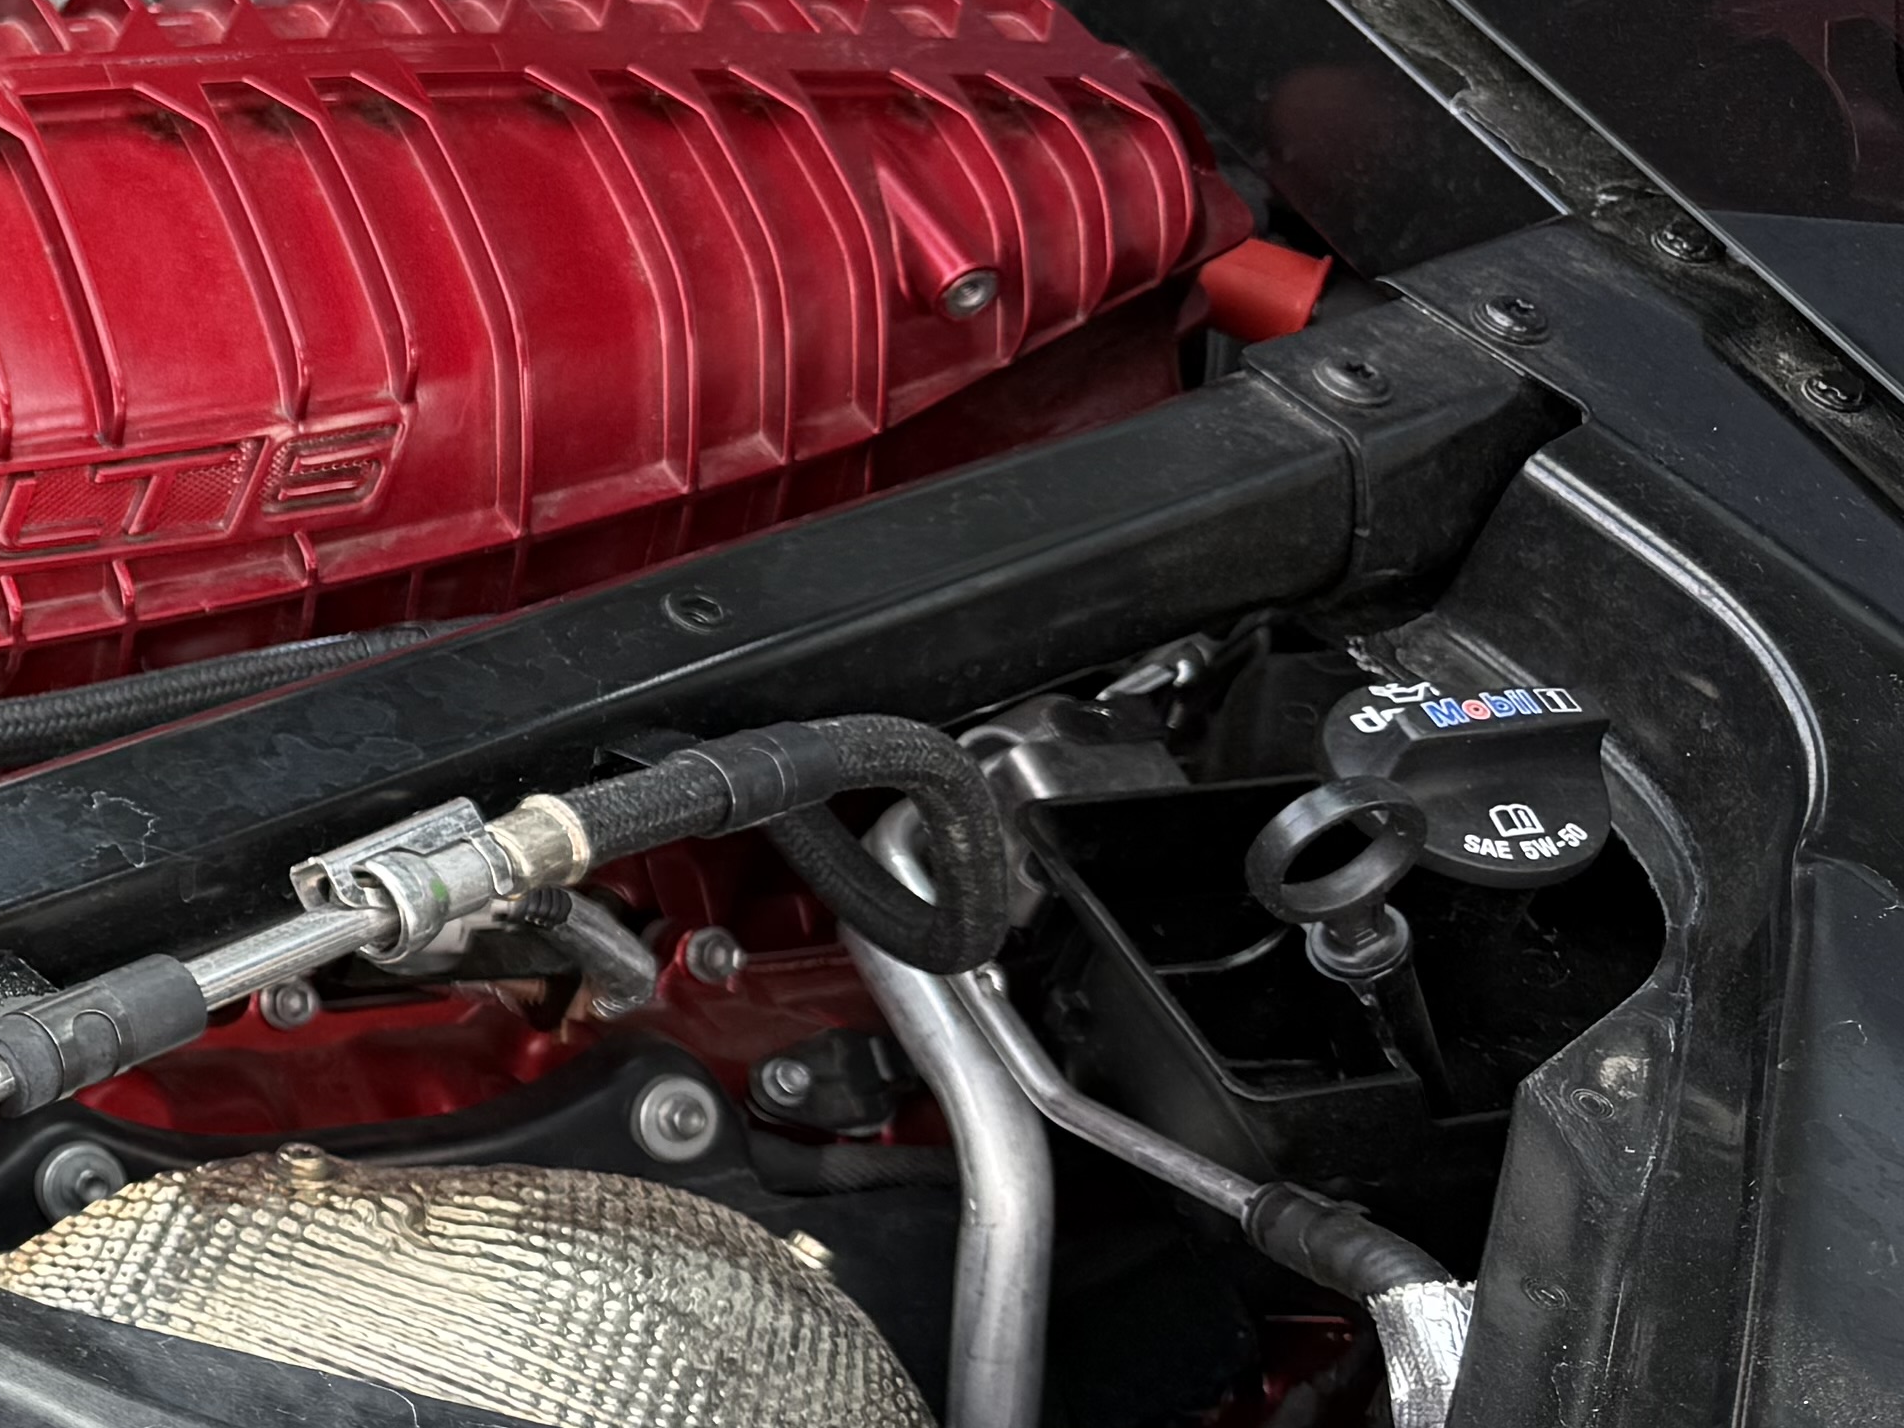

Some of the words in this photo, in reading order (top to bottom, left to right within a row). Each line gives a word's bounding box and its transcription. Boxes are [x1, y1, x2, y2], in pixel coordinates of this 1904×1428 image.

[1421, 687, 1541, 728] Mobil
[1463, 834, 1514, 861] SAE
[1518, 822, 1589, 862] 5W-50
